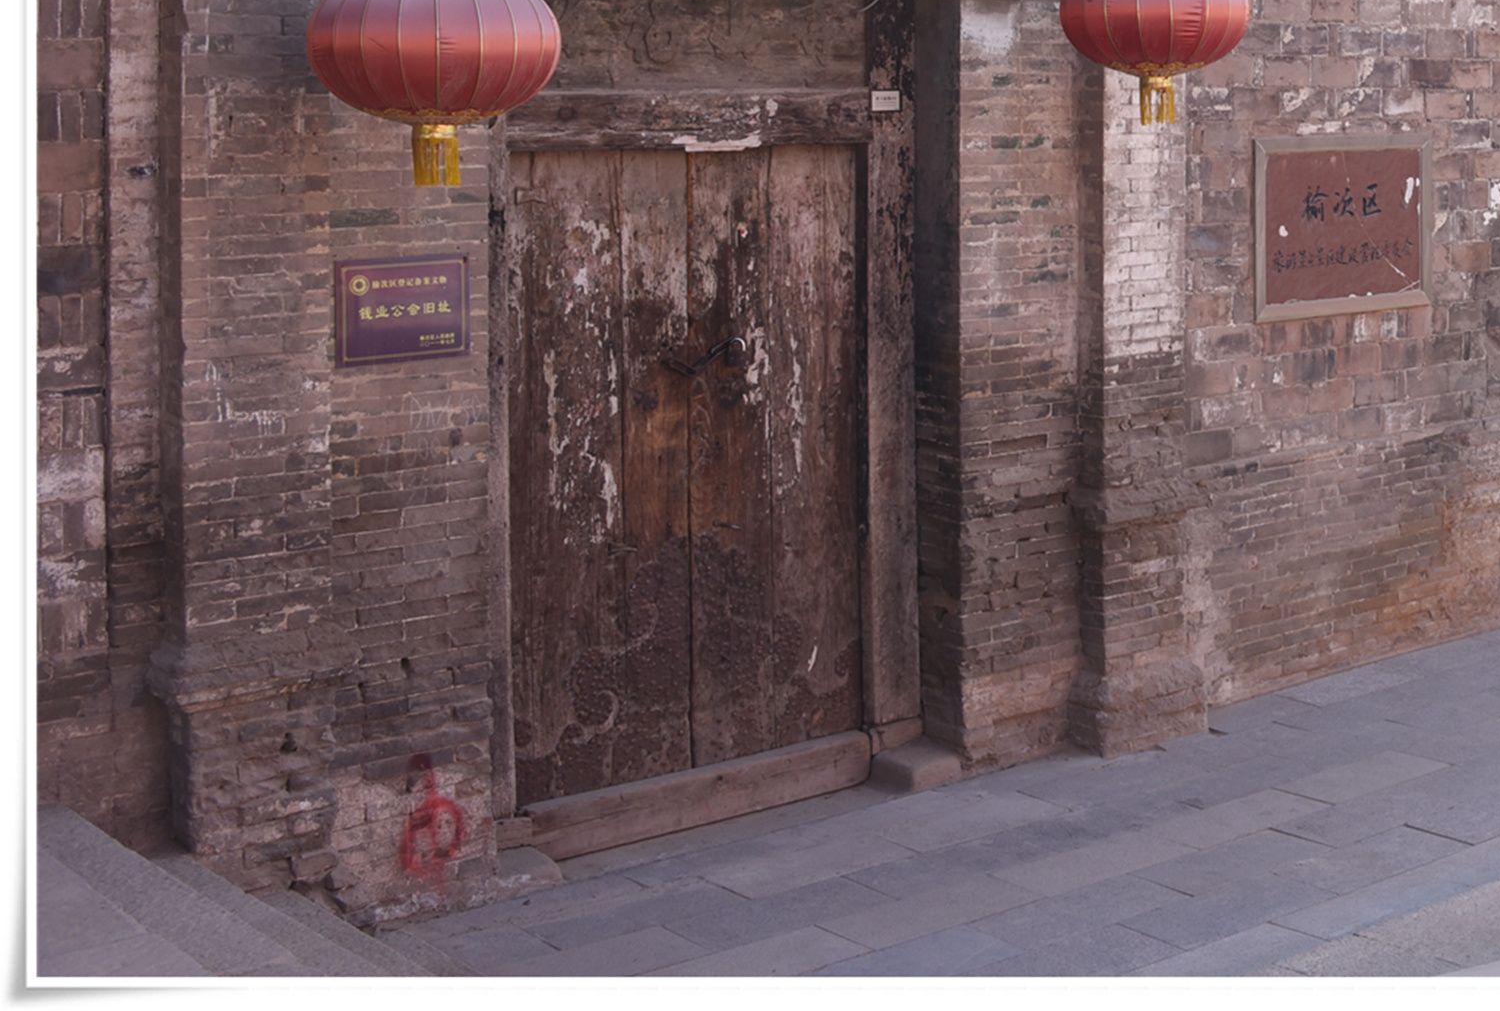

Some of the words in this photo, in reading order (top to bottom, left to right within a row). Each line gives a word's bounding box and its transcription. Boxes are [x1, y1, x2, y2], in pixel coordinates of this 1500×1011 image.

[1301, 183, 1382, 223] 榆次区
[358, 300, 452, 320] 钱业公会旧址
